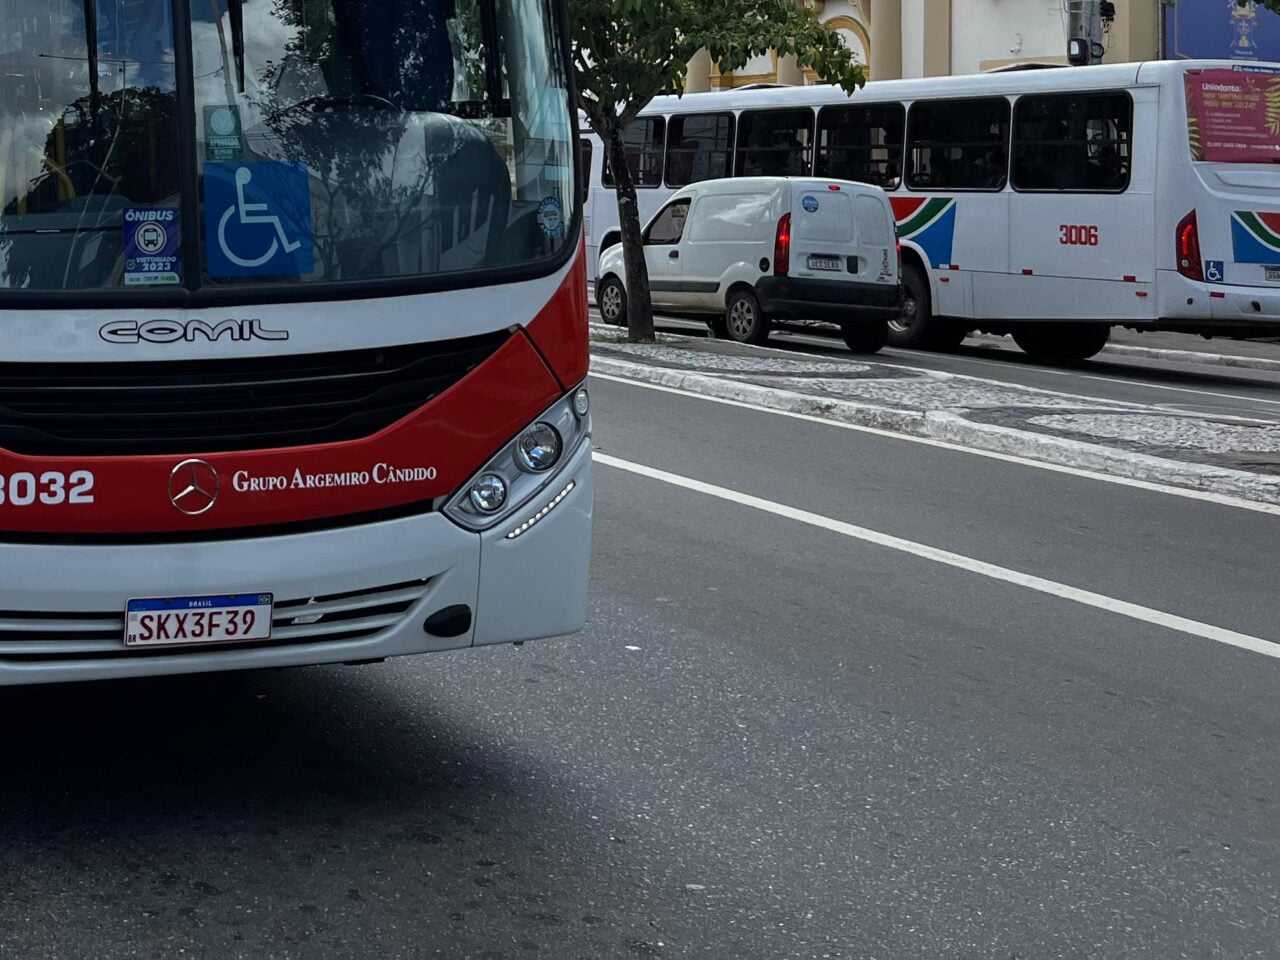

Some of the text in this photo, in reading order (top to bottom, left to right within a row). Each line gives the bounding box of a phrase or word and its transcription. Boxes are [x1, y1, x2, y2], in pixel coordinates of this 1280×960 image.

[125, 208, 174, 222] ÔNIBUS
[1059, 224, 1099, 246] 3006
[142, 262, 171, 271] 2023
[98, 319, 289, 344] COMIL
[188, 600, 213, 608] BRASIL
[138, 609, 257, 642] SKX3F39
